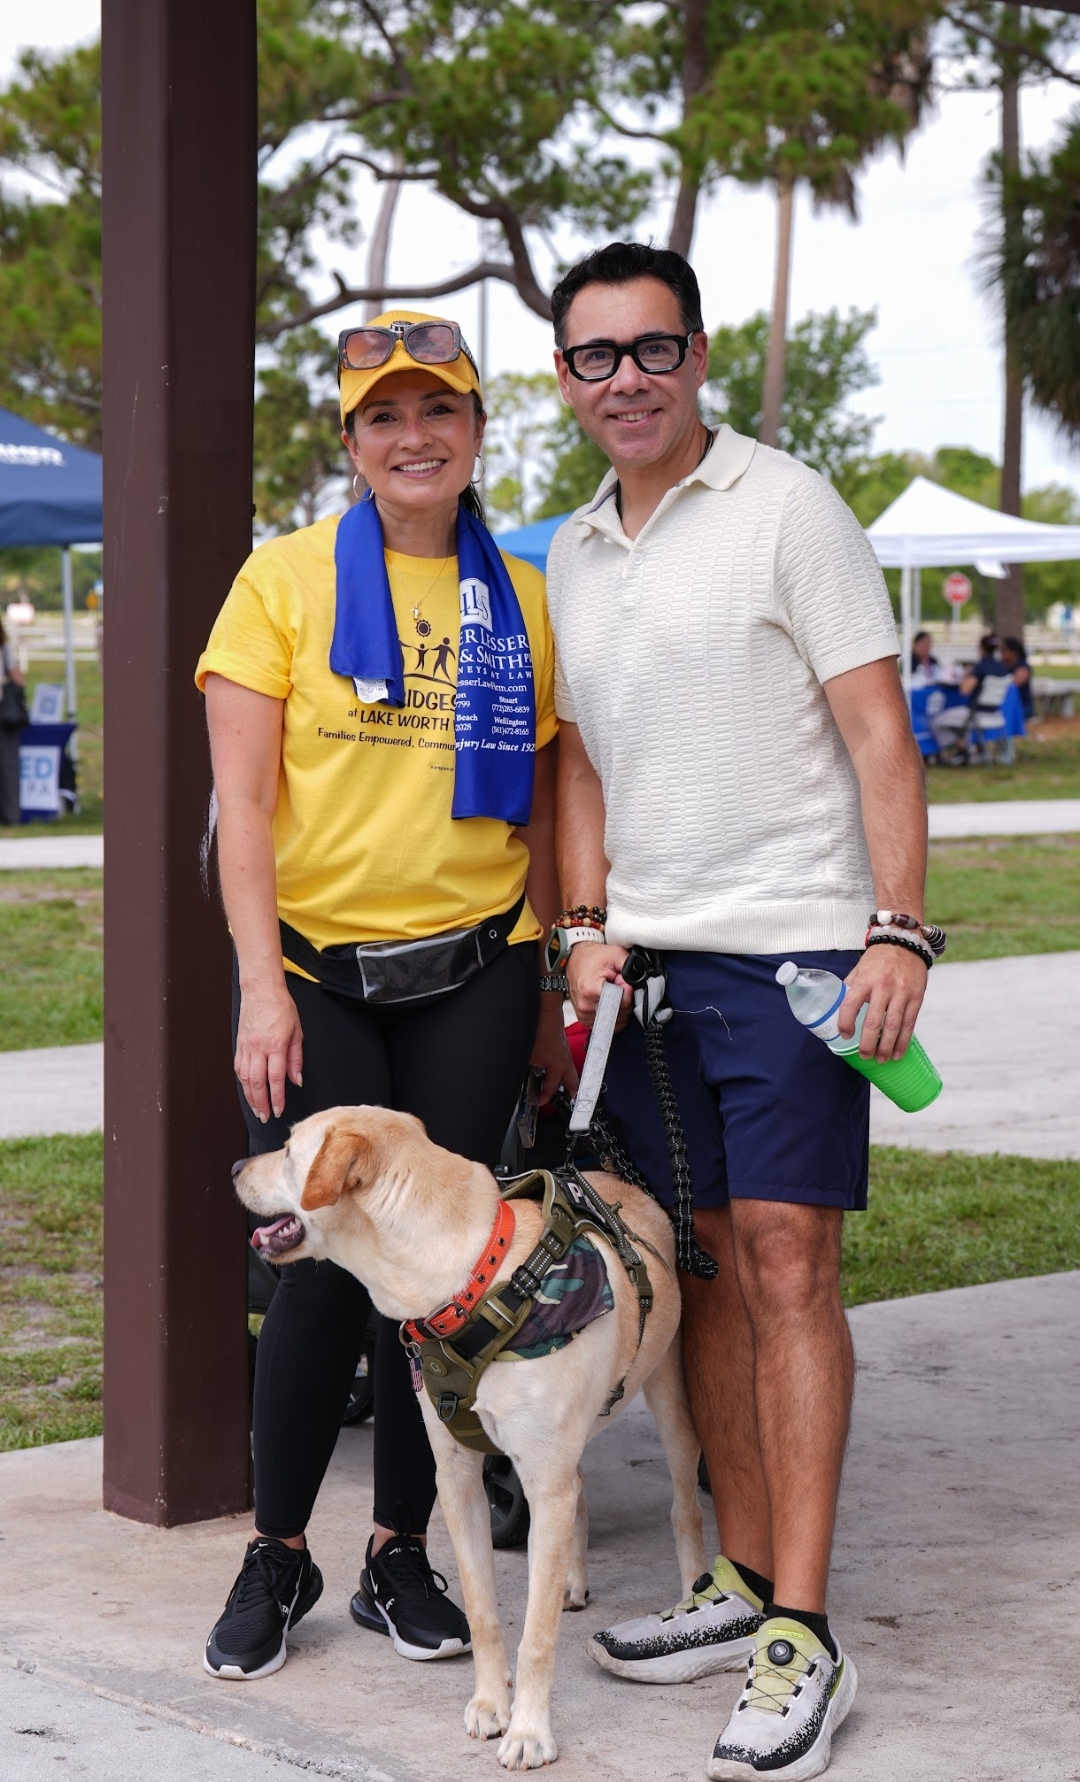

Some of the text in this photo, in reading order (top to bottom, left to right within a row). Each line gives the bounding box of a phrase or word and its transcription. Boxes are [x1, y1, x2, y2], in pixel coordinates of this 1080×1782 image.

[480, 627, 529, 652] LESSER
[460, 648, 476, 663] &
[476, 645, 524, 669] SMITH
[490, 671, 500, 679] AT
[508, 671, 532, 679] LAW
[499, 696, 518, 704] Stuart
[348, 708, 358, 718] at
[360, 710, 395, 726] LAKE
[397, 714, 450, 731] WORTH
[456, 713, 478, 722] Beach
[494, 716, 527, 727] Wellington
[317, 727, 356, 742] Families
[358, 731, 415, 748] Empowered.
[455, 738, 480, 751] njury
[481, 739, 497, 750] Law
[497, 741, 519, 752] Since
